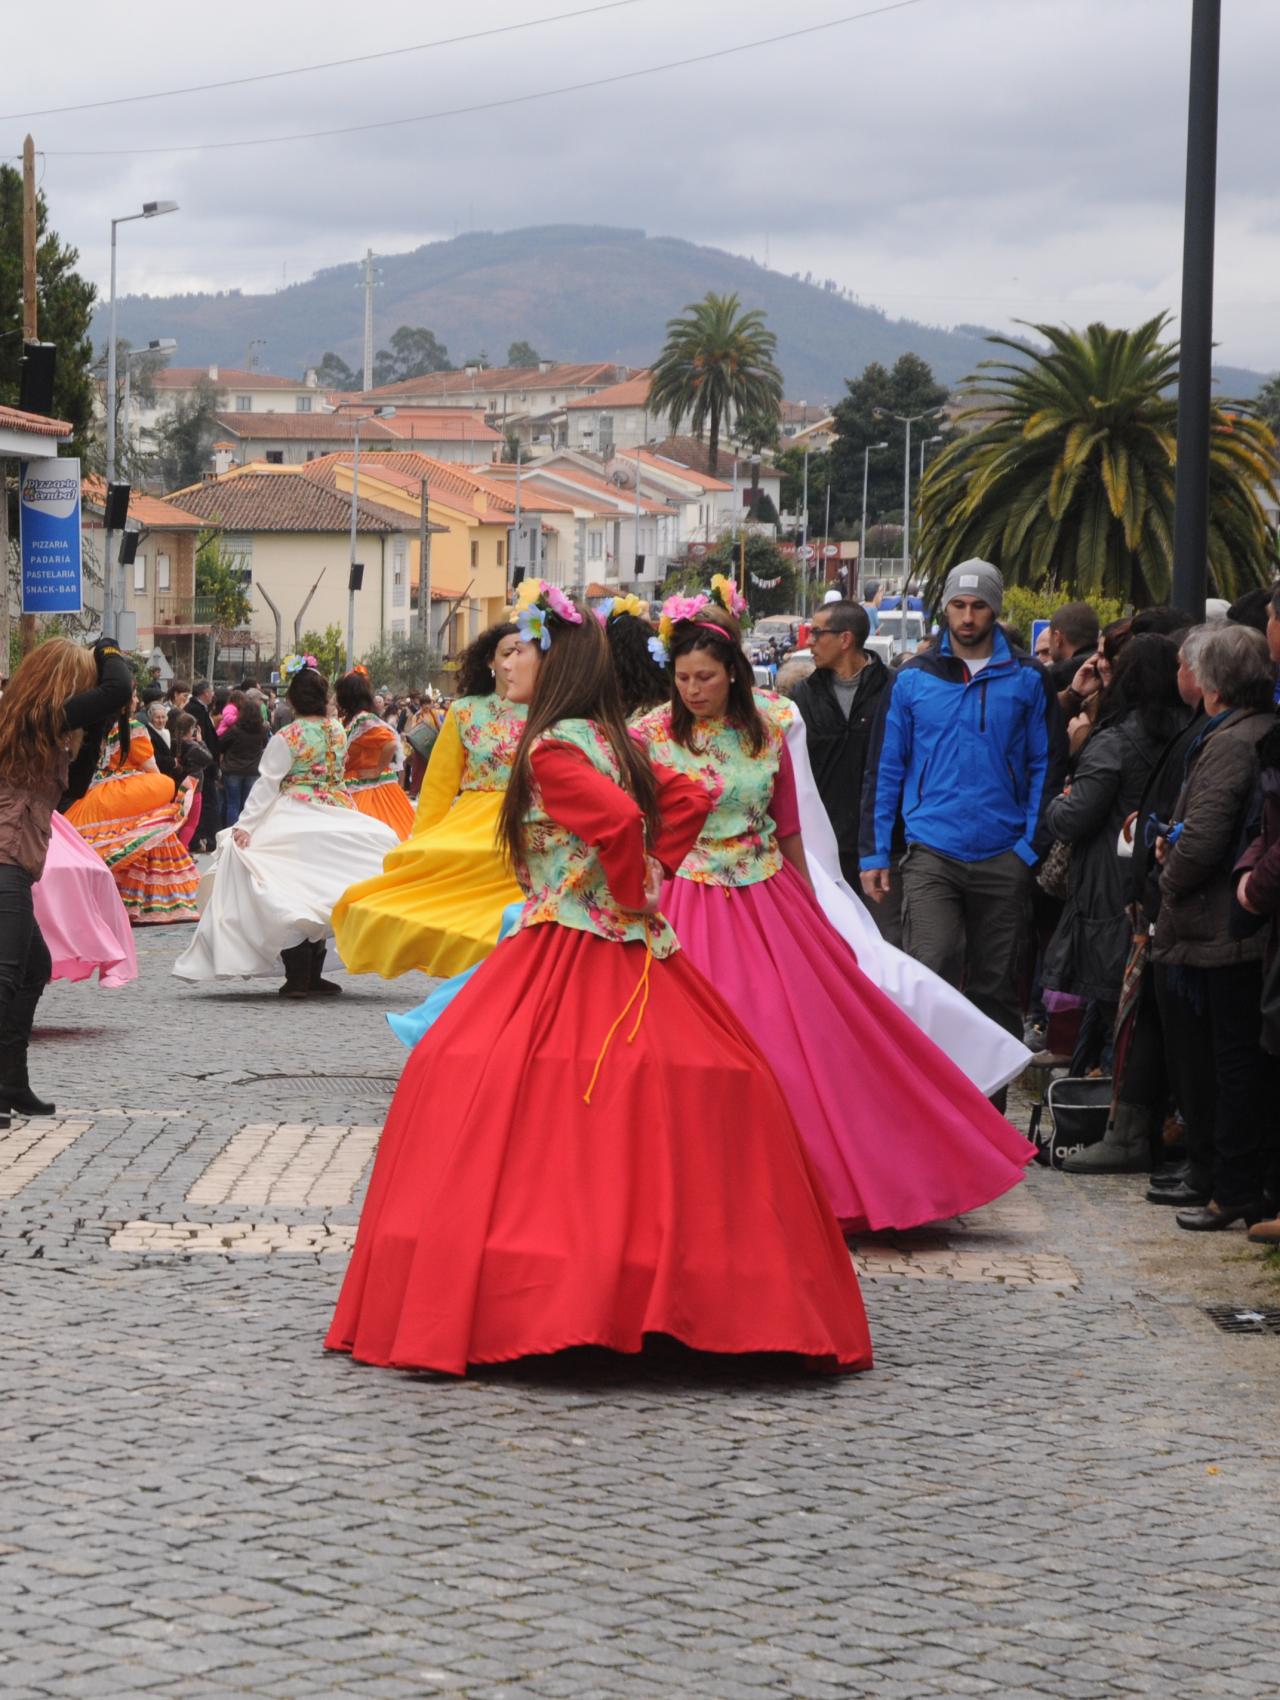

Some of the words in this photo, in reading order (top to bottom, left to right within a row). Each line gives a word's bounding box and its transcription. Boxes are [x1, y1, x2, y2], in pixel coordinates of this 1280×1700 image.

[32, 541, 69, 549] PIZZARIA
[30, 556, 71, 564] PADARIA
[26, 570, 76, 579] PASTELARIA
[25, 585, 77, 594] SNACK-BAR
